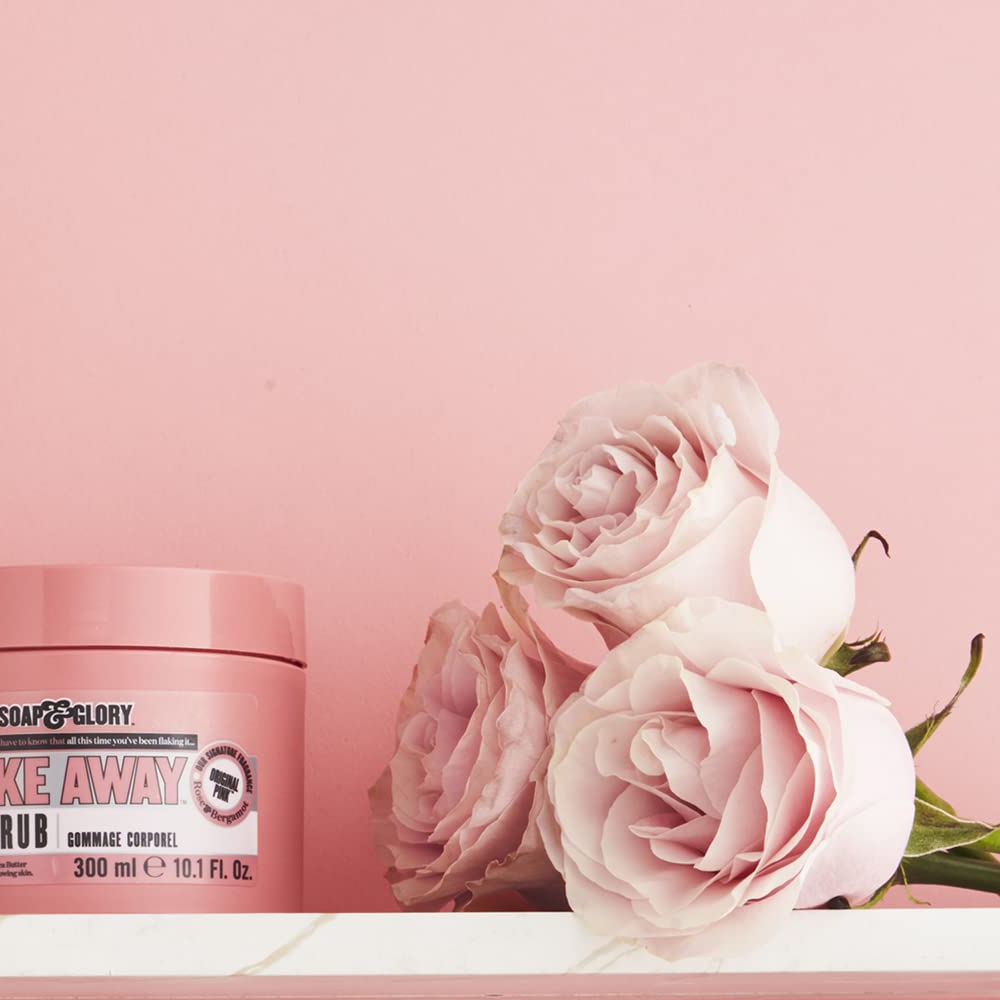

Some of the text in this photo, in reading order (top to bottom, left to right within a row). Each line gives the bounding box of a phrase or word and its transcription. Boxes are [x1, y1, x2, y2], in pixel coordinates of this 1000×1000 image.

[0, 739, 18, 747] have
[27, 738, 48, 746] know
[49, 737, 66, 745] that
[67, 736, 76, 744] all
[77, 736, 93, 744] this
[93, 736, 112, 744] time
[112, 736, 138, 747] you've
[138, 737, 157, 745] been
[158, 737, 184, 748] flaking
[59, 755, 188, 806] AWAY
[67, 831, 178, 849] GOMMAGE CORPOREL
[74, 856, 107, 879] 300
[115, 856, 137, 878] ml
[174, 857, 203, 880] 10.1
[210, 858, 228, 880] Fl.
